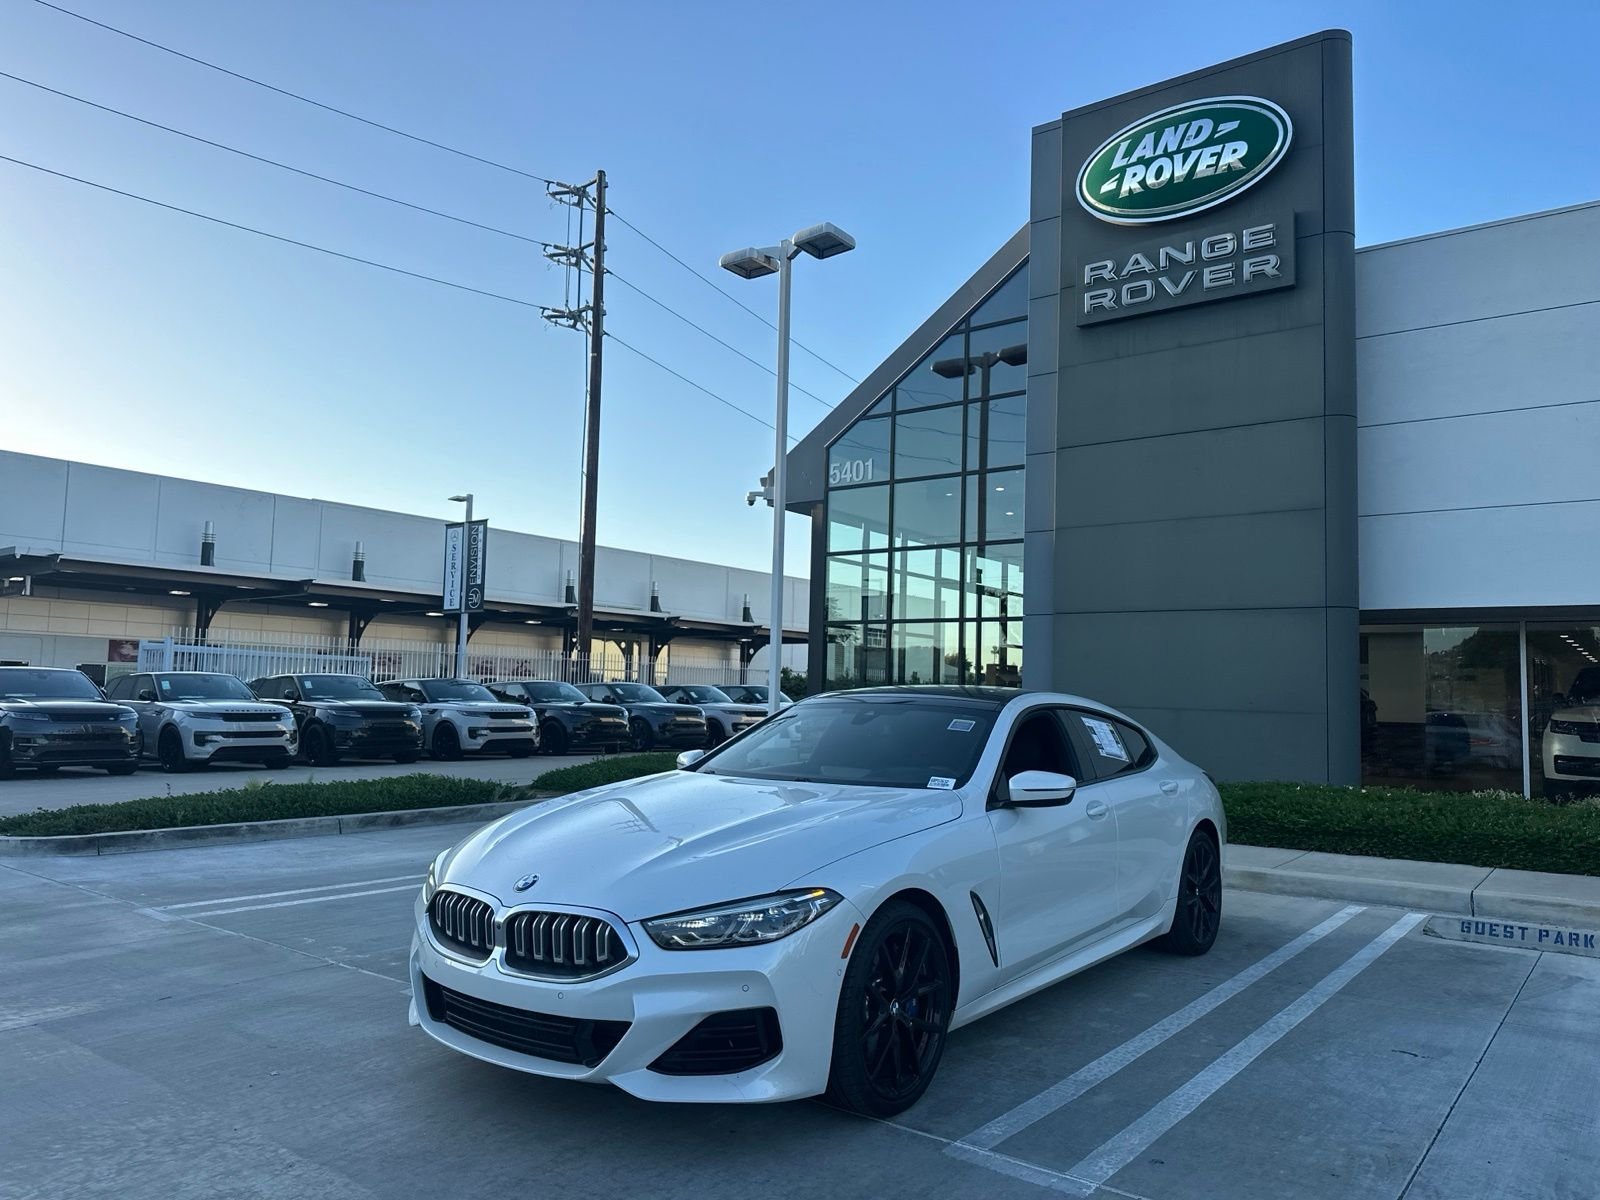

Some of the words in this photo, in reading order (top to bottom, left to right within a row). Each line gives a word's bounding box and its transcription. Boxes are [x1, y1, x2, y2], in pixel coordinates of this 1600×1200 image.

[1084, 223, 1278, 286] RANGE
[1084, 254, 1283, 315] ROVER
[829, 458, 873, 484] 5401
[449, 543, 457, 607] SERVICE
[469, 525, 479, 585] ENVISION
[1460, 920, 1529, 941] GUEST
[1538, 928, 1596, 949] PARK
